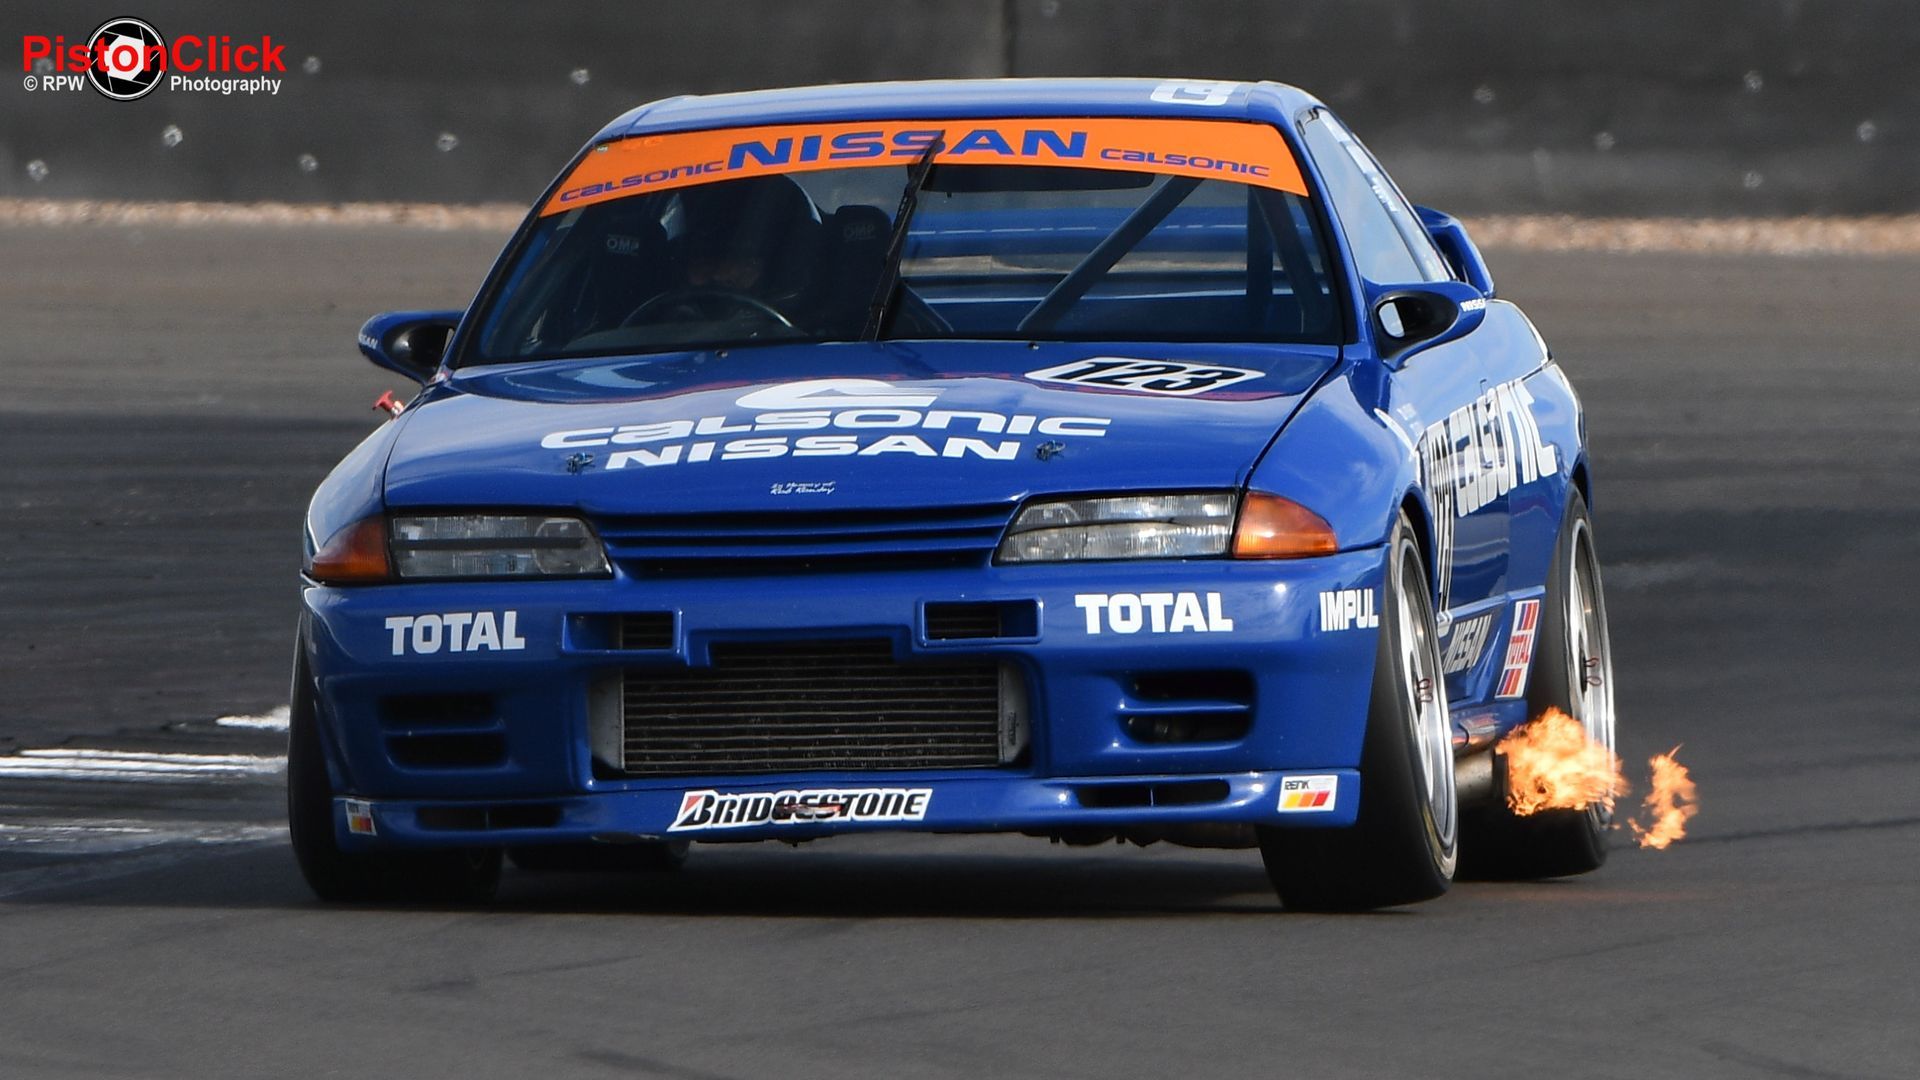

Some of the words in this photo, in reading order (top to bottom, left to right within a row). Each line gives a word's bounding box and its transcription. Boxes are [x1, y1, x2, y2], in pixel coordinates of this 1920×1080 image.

[727, 129, 1088, 170] NISSAN
[1049, 361, 1246, 391] 123
[605, 436, 1021, 470] NISSAN
[1075, 592, 1233, 634] TOTAL
[1319, 588, 1379, 631] IMPUL
[385, 611, 525, 655] TOTAL
